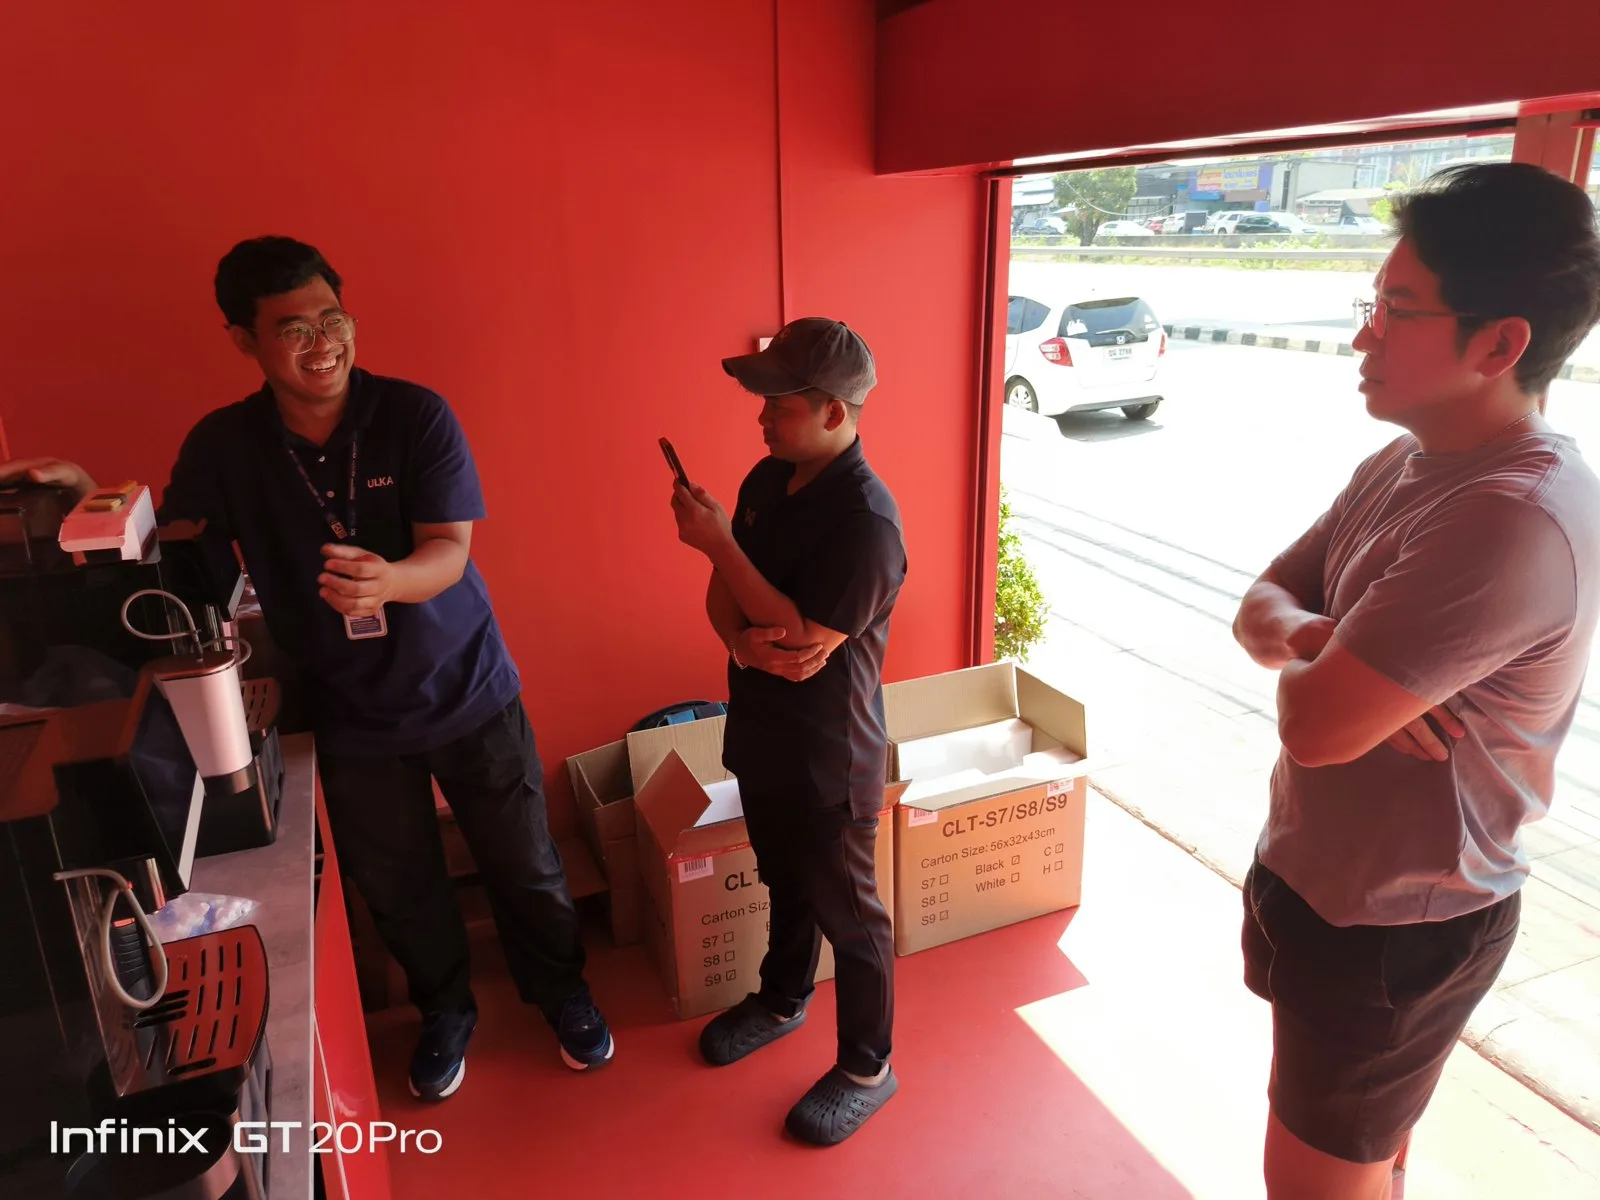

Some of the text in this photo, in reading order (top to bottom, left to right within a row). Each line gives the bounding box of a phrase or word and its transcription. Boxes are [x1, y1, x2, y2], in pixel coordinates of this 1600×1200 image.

[367, 476, 394, 488] ULKA
[943, 793, 1067, 837] CLT-S7/S8/S9
[921, 827, 1055, 869] Carton Size: 56x32x43cm
[1044, 847, 1052, 857] C
[975, 859, 1004, 875] Black
[1043, 864, 1051, 874] H
[921, 878, 936, 890] S7
[976, 876, 1006, 893] White
[921, 896, 936, 908] S8
[702, 901, 771, 926] Carton Siz
[921, 914, 936, 926] S9
[702, 935, 719, 949] S7
[703, 954, 720, 968] S8
[704, 974, 721, 987] S9
